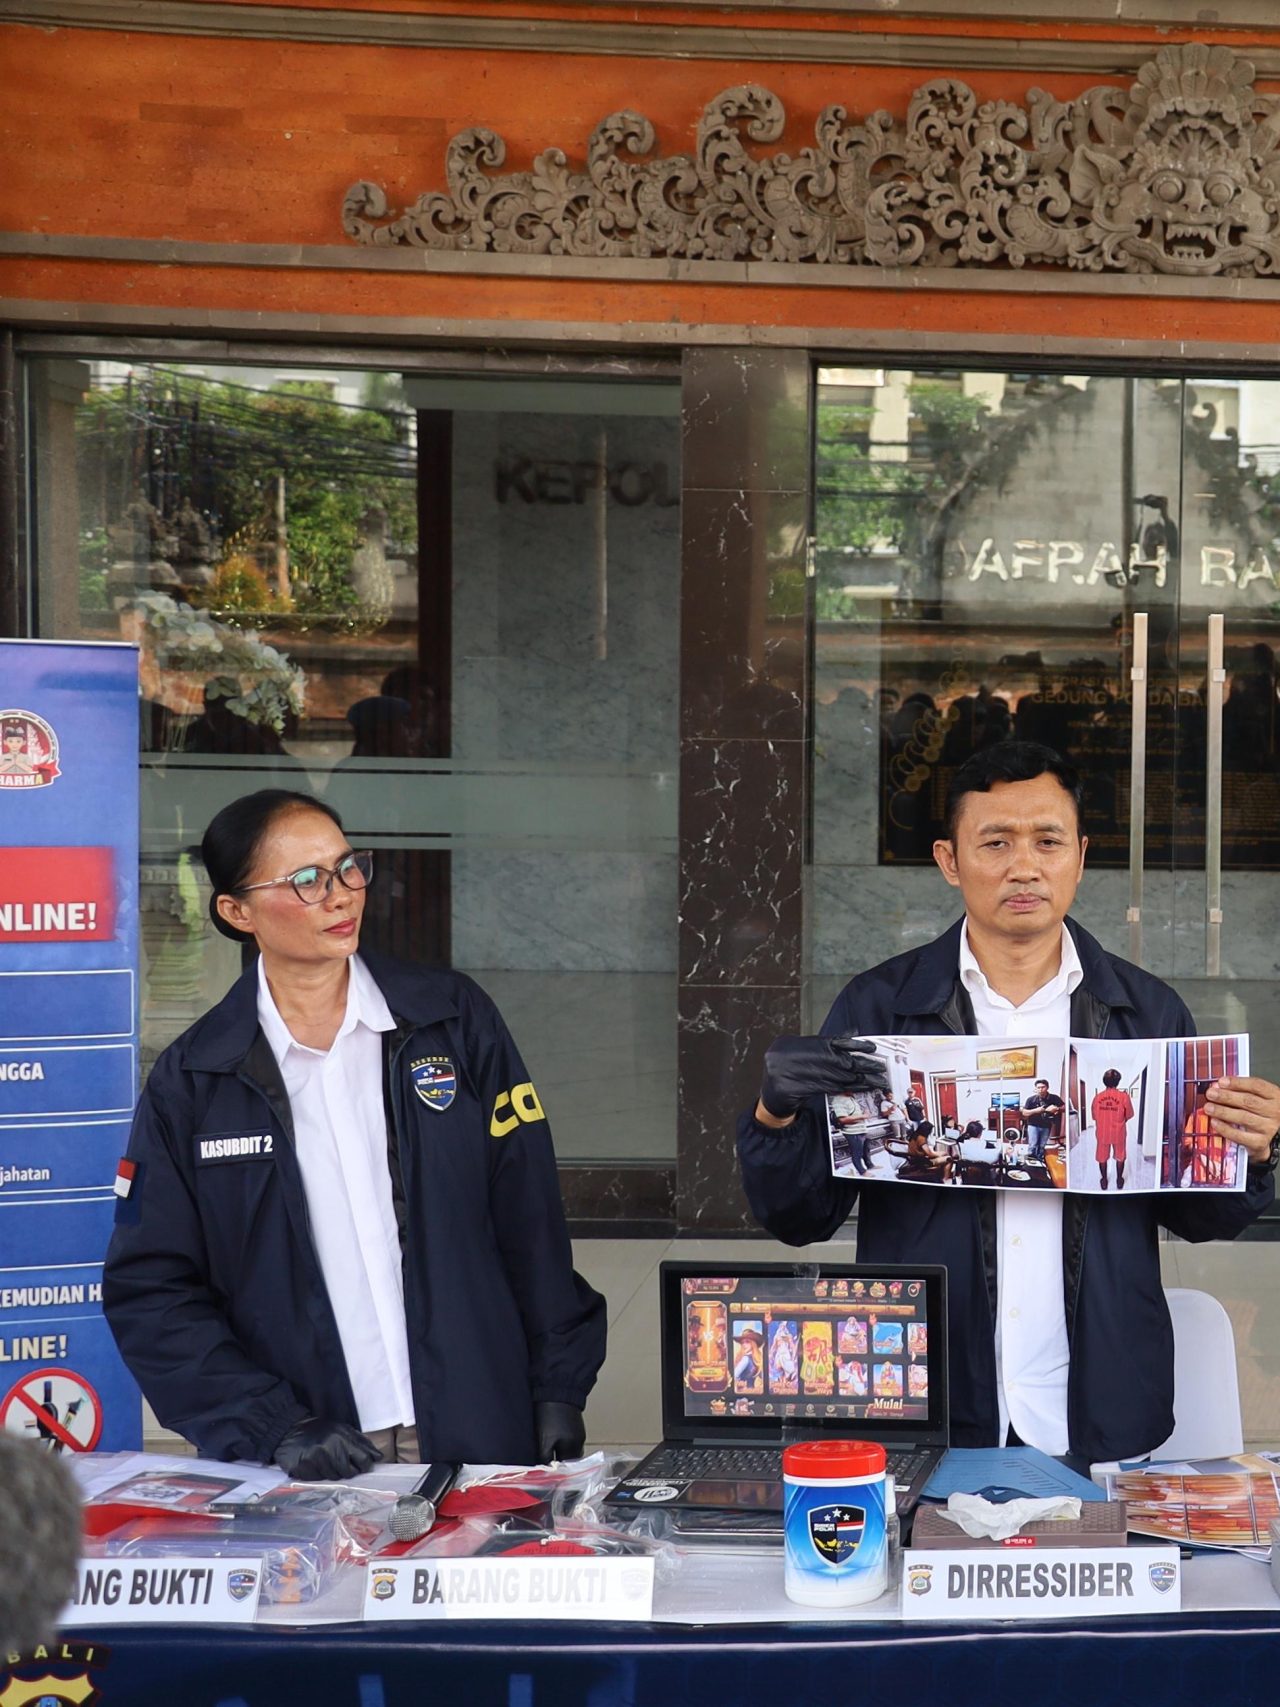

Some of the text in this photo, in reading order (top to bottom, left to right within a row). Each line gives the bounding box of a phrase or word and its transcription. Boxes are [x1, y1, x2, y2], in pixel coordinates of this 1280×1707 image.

[200, 1134, 274, 1159] KASUBDIT 2
[0, 1284, 84, 1308] EMUDIAN
[873, 1398, 904, 1410] Mulai
[129, 1568, 214, 1605] BUKTI
[412, 1567, 607, 1605] BARANG BUKTI
[948, 1562, 1134, 1599] DIRRESSIBER
